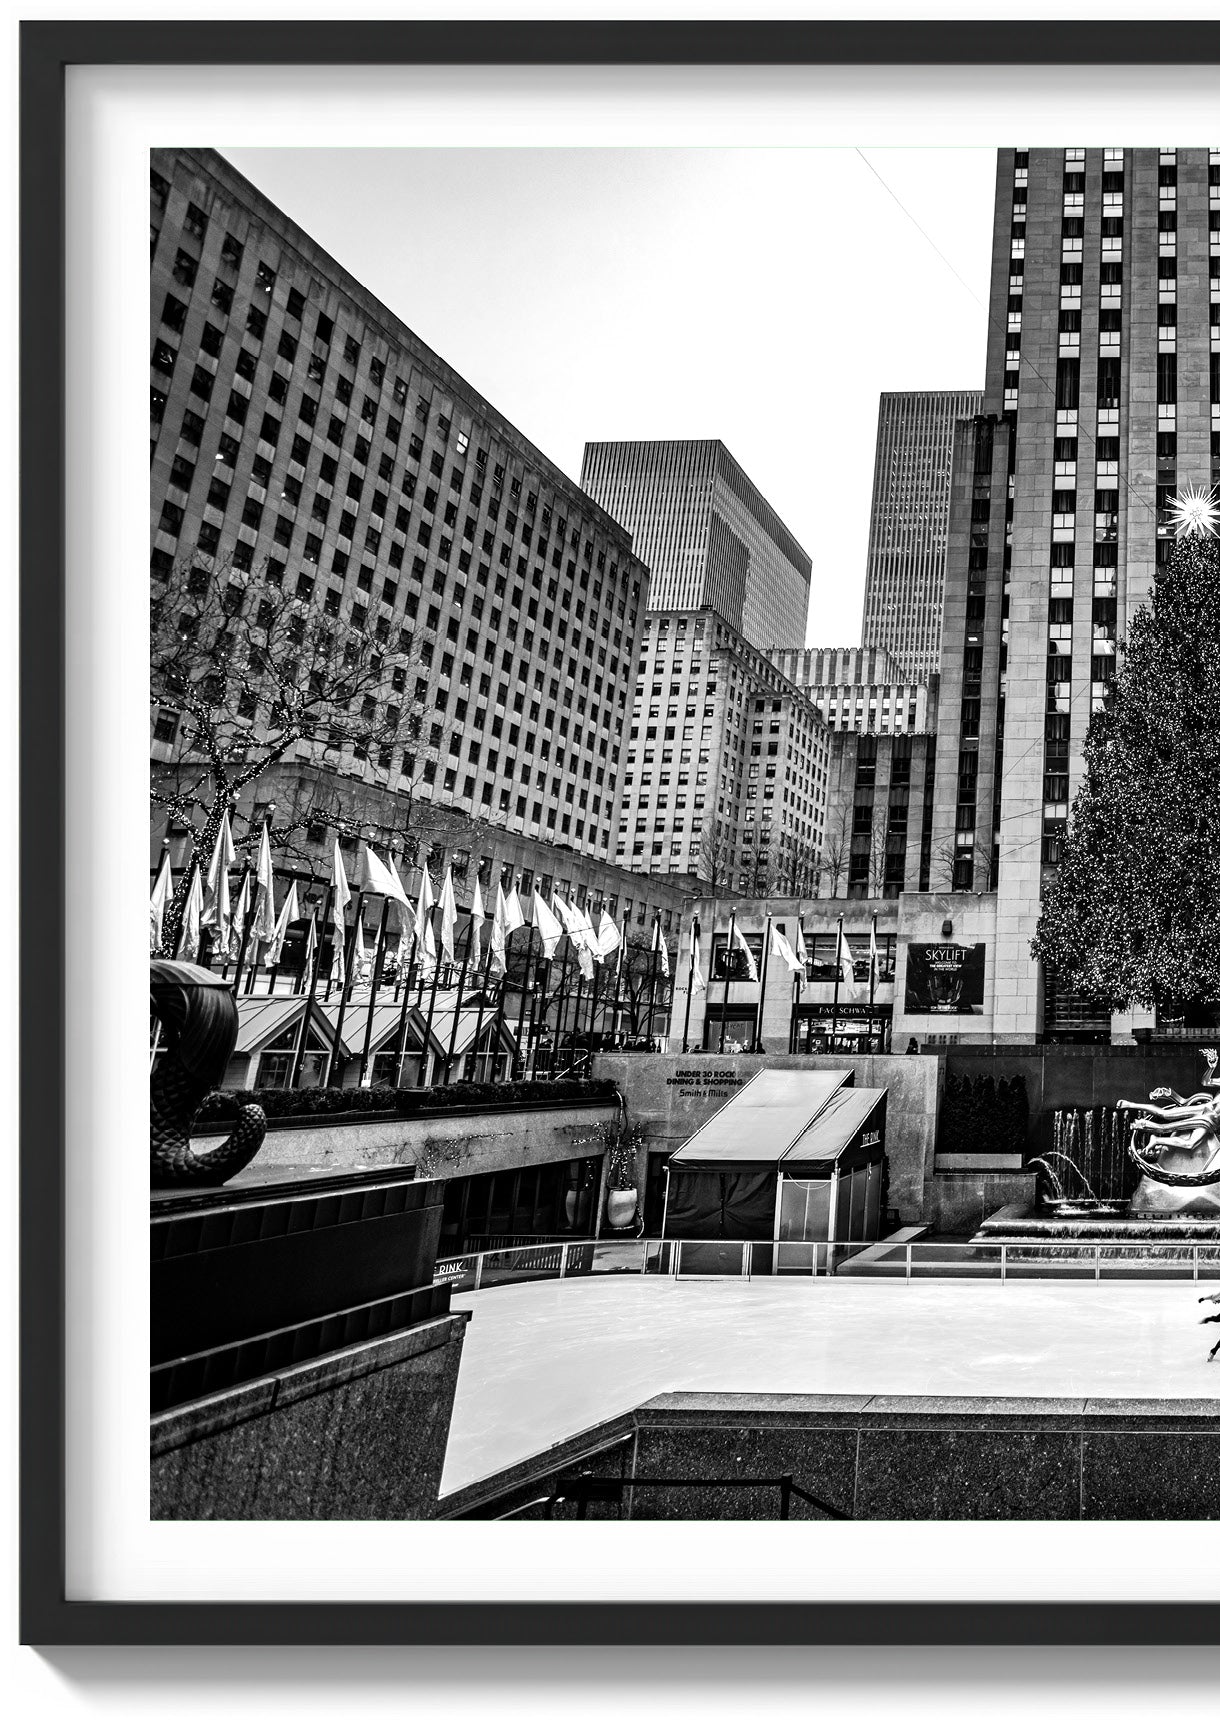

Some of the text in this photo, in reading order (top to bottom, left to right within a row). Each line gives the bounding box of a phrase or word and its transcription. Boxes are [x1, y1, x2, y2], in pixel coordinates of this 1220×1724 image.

[925, 949, 967, 961] SKYLIFT
[680, 1089, 701, 1097] Smith
[708, 1089, 728, 1097] Mills
[440, 1262, 463, 1275] RINK
